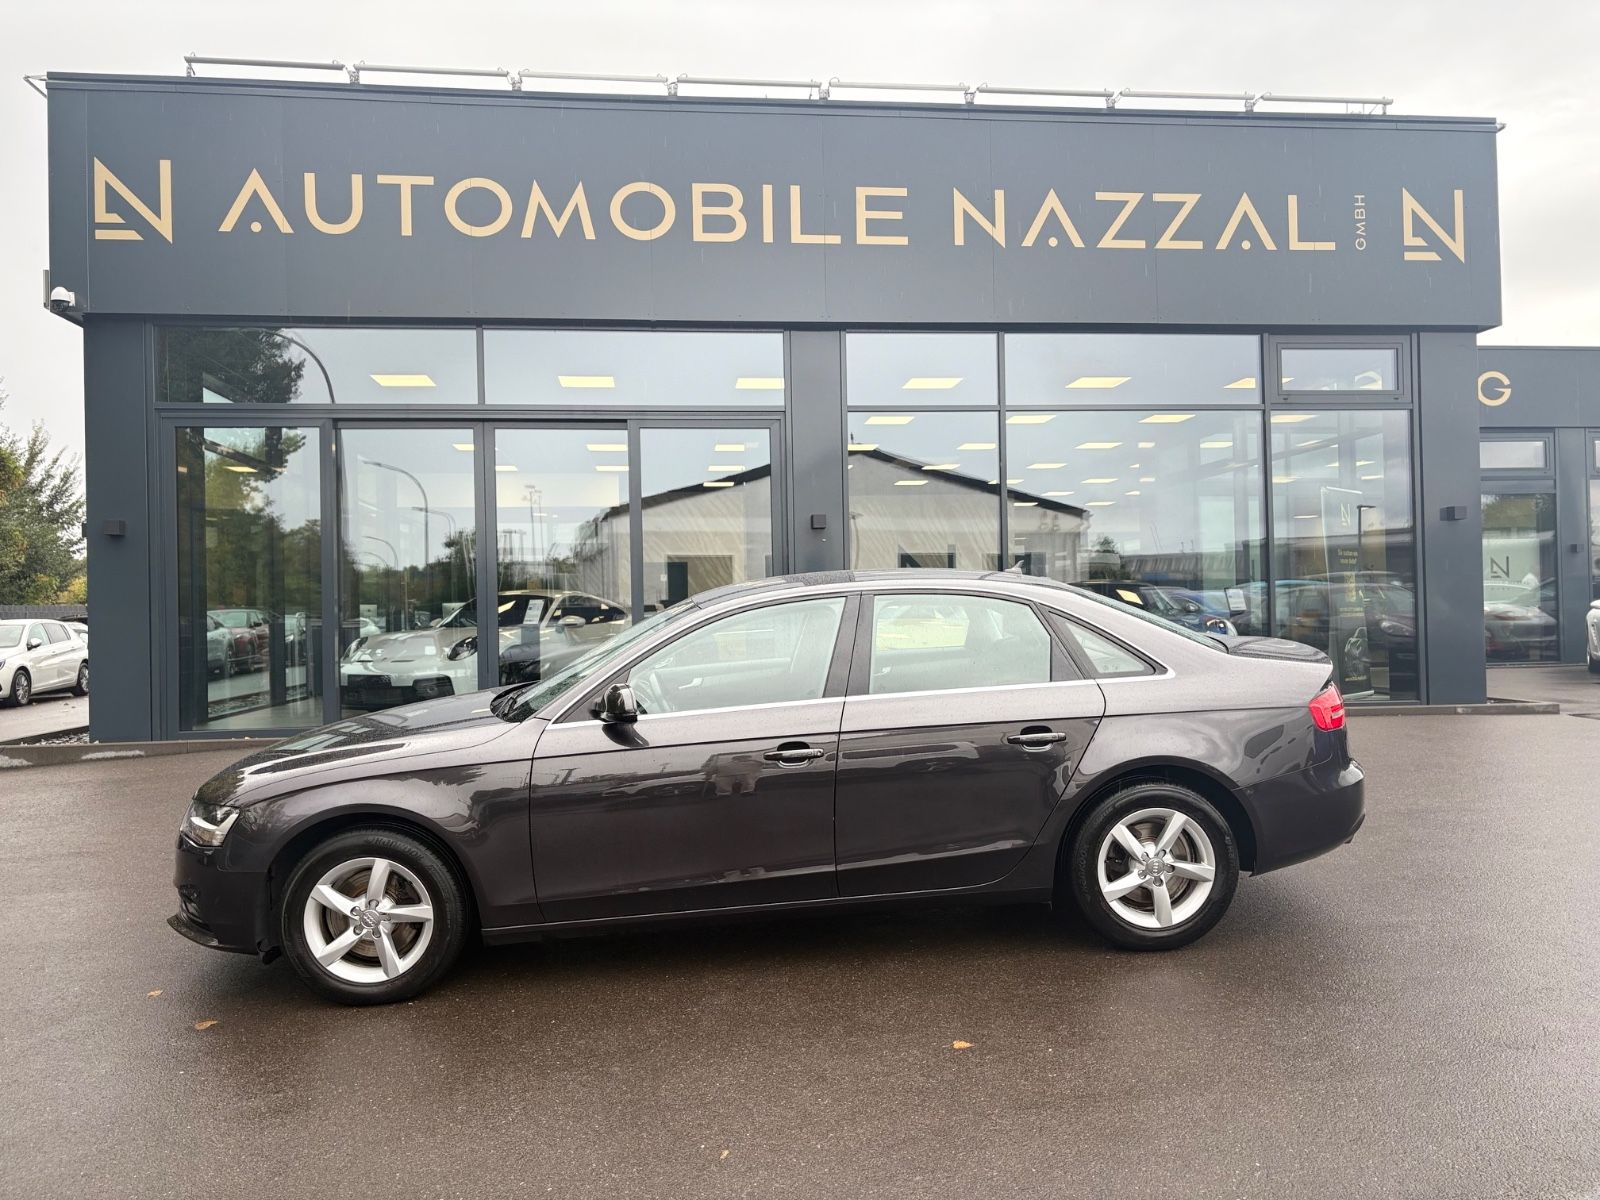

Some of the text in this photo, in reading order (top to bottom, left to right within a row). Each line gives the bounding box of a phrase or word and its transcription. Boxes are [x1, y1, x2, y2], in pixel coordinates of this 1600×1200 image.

[218, 168, 1337, 252] AUTOMOBILE NAZZAL
[1353, 193, 1367, 251] GMBH
